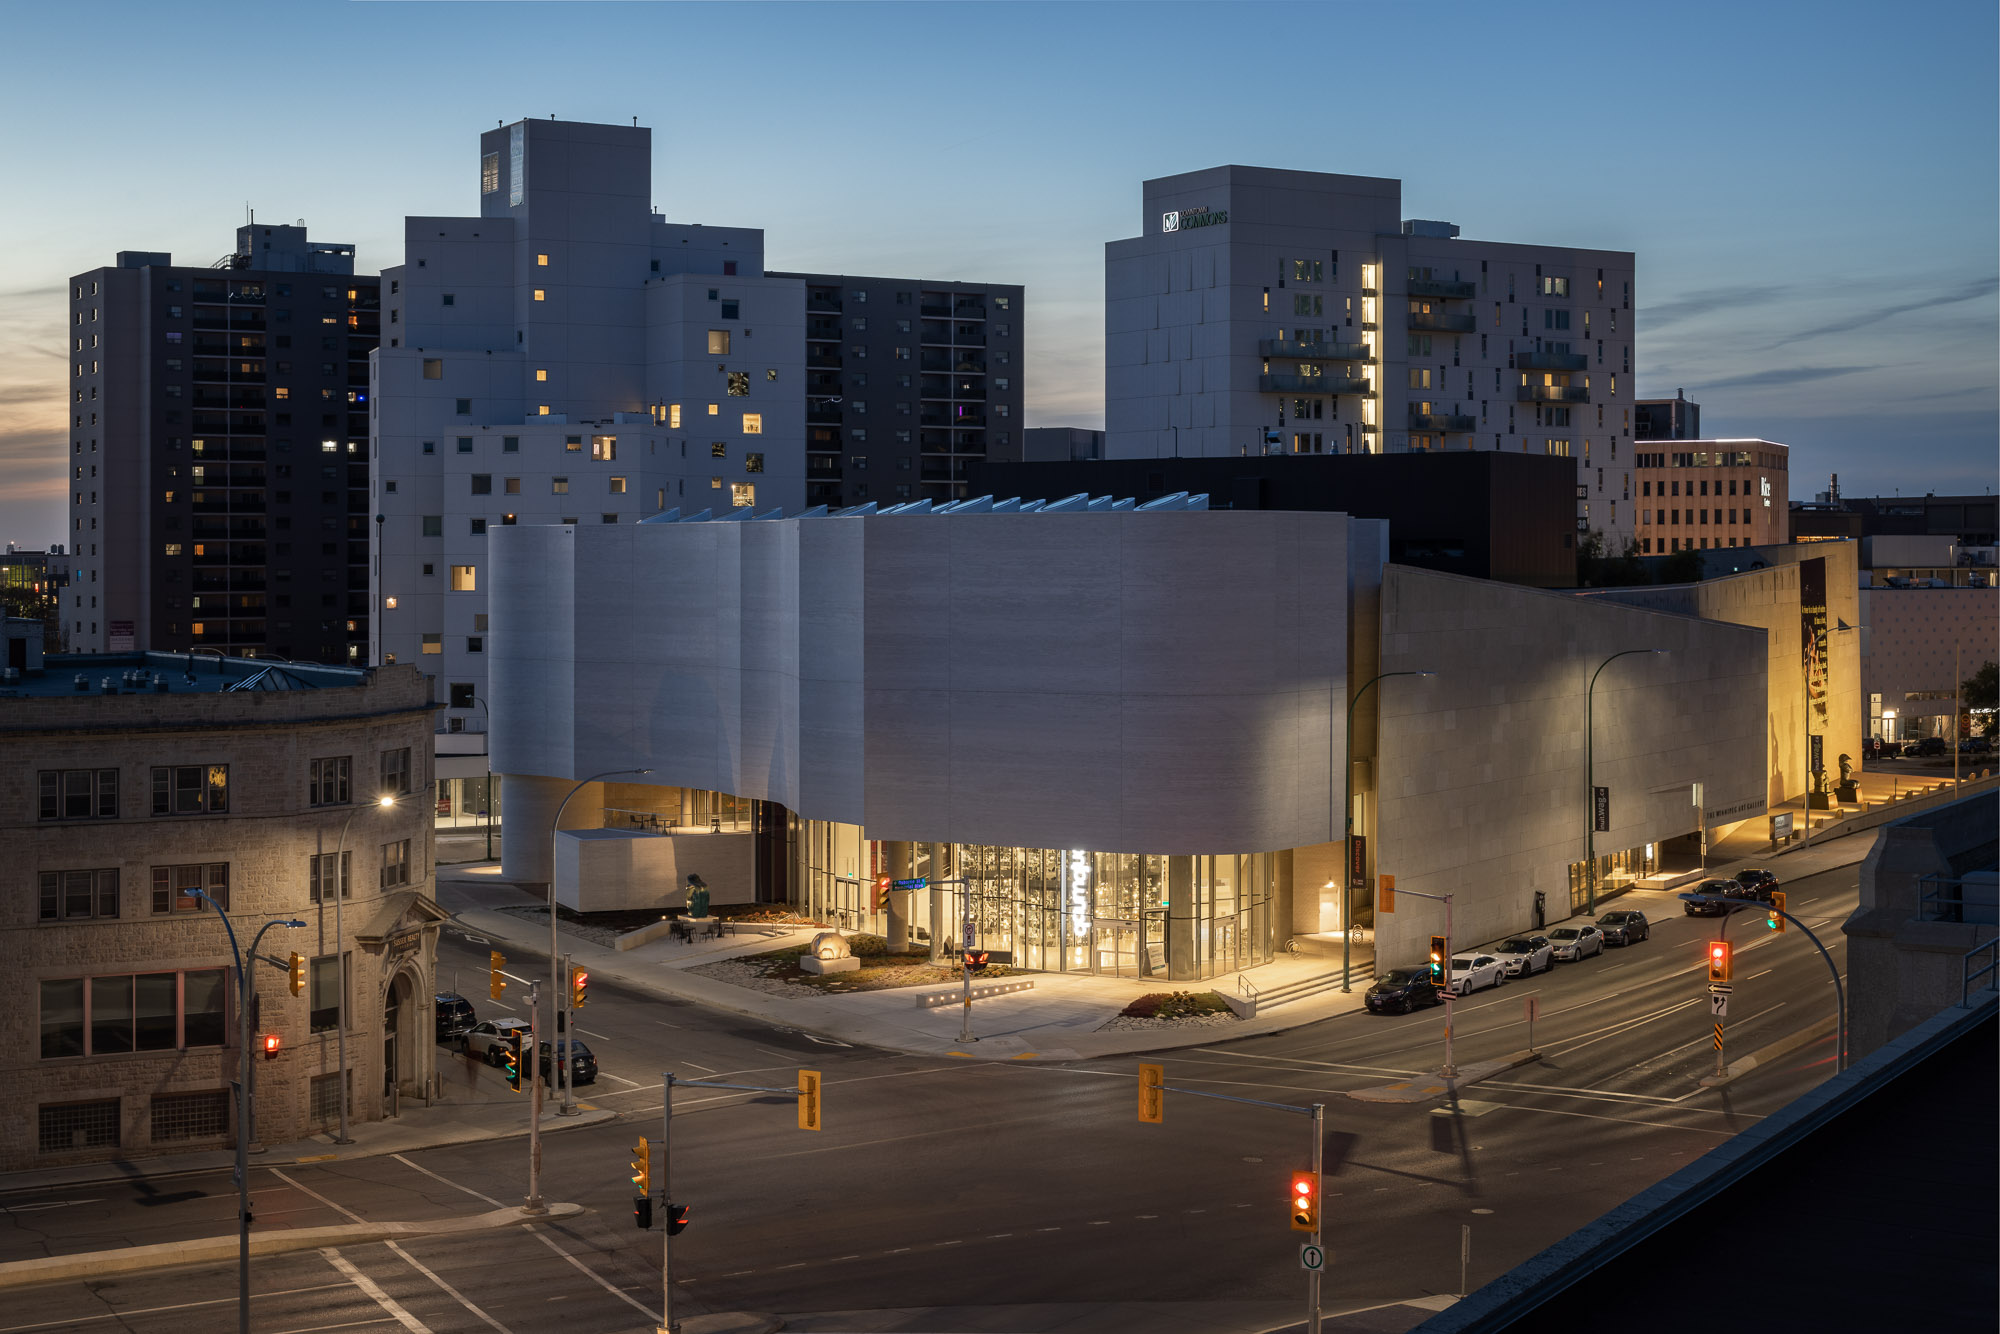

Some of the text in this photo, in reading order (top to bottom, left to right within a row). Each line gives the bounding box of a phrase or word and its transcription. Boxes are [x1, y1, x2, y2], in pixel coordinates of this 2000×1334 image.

[1180, 206, 1209, 217] DOWNTOWN
[1181, 211, 1227, 229] COMMONS
[1598, 788, 1606, 830] inuit.wag.ca
[1706, 799, 1765, 819] THE WINNIPEG ART GALLERY
[1071, 850, 1092, 935] qaumaju
[408, 933, 419, 942] REALTY
